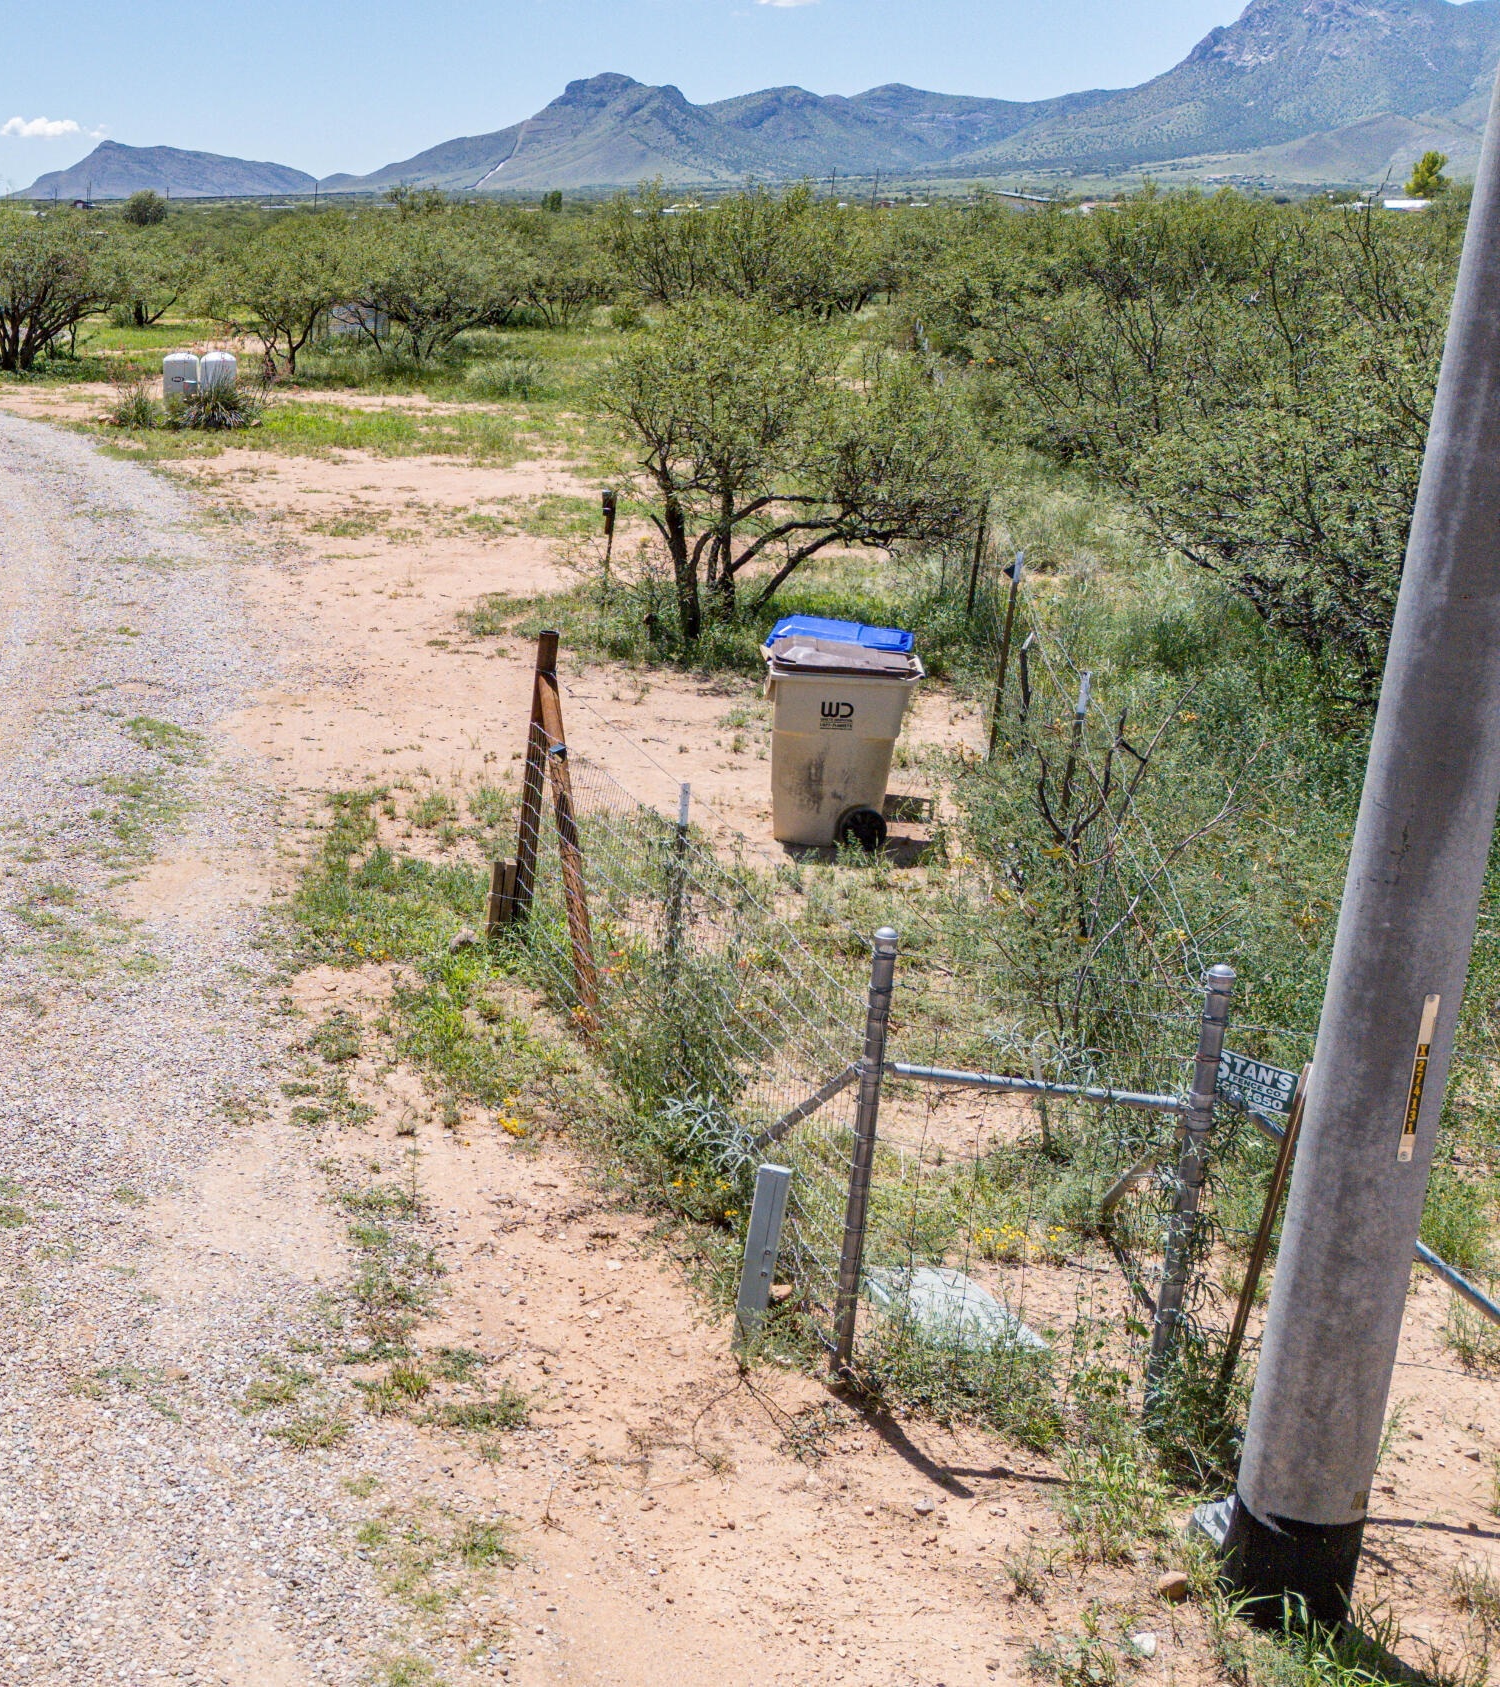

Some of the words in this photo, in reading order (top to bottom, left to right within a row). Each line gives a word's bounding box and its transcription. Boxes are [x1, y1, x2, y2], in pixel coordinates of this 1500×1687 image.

[821, 701, 854, 718] WD
[1217, 1051, 1293, 1091] STAN'S
[1233, 1074, 1263, 1092] FENCE
[1406, 1060, 1426, 1134] 274131
